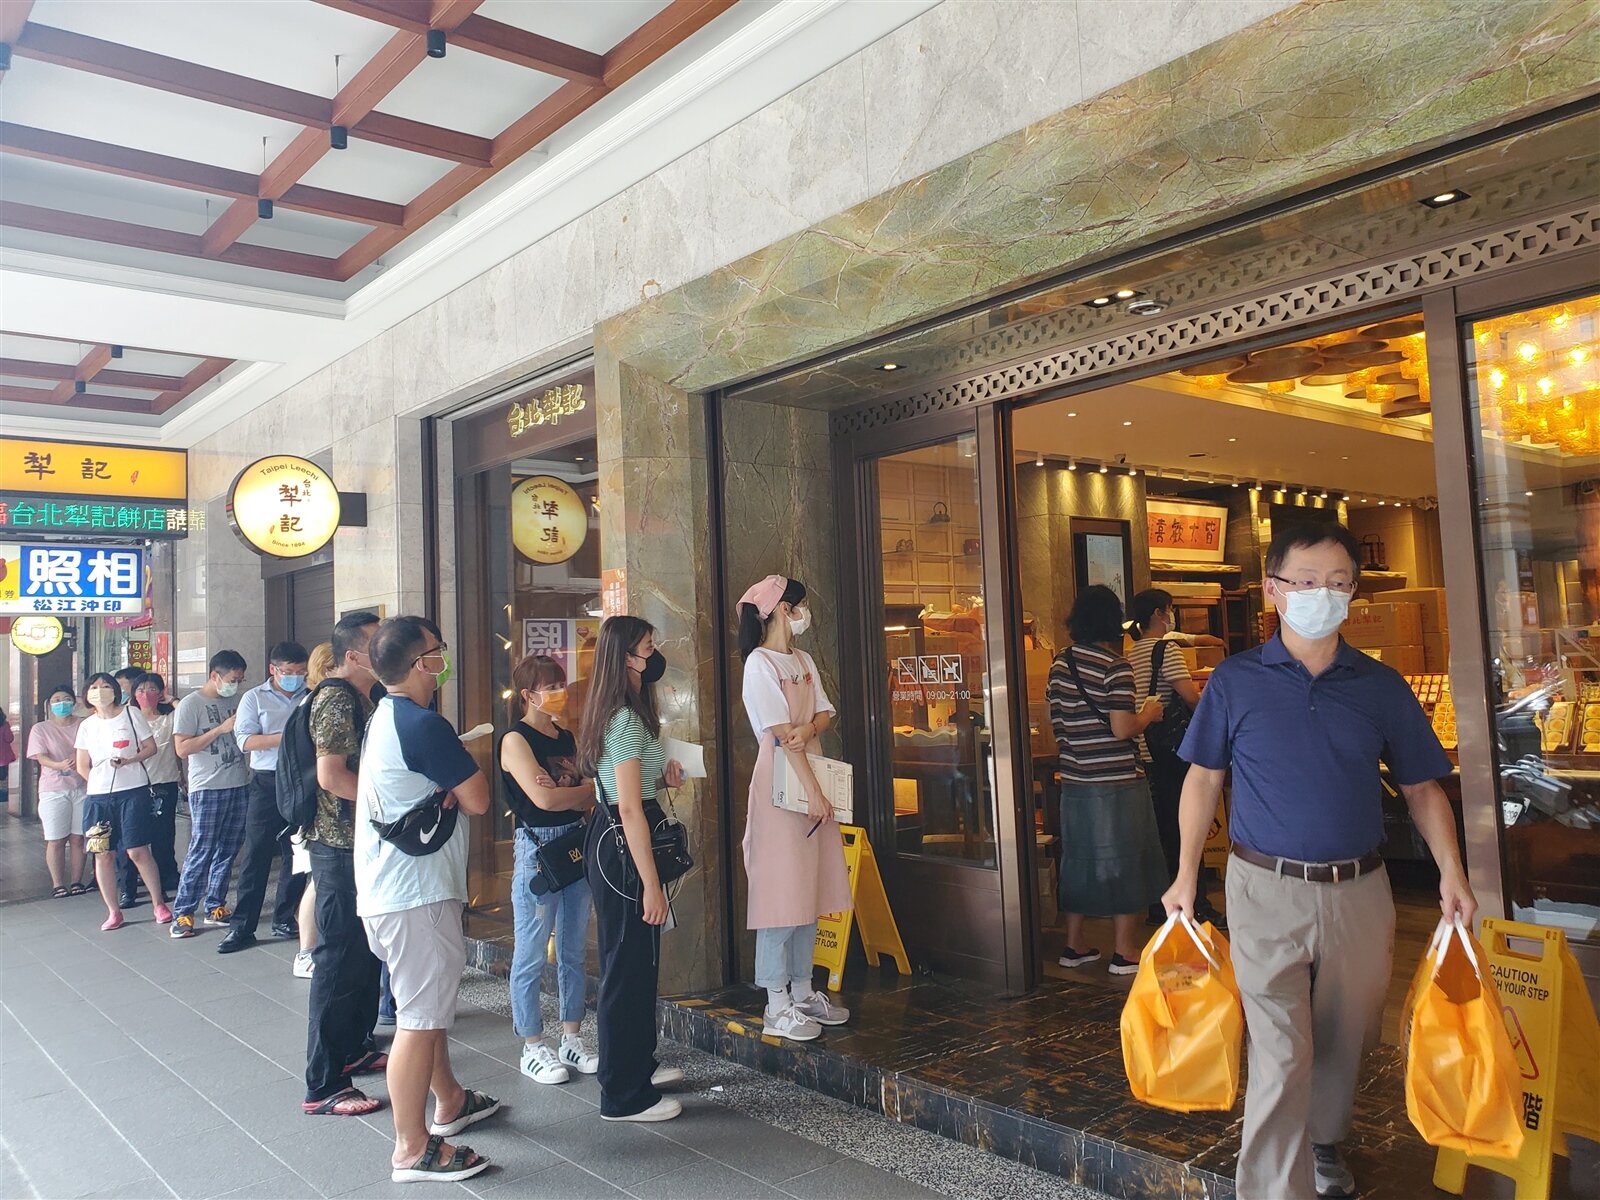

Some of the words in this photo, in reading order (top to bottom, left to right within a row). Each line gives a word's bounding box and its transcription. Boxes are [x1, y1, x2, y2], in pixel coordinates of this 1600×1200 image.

[507, 384, 586, 438] 台北犁記
[24, 451, 112, 480] 犁記
[260, 464, 288, 476] Taipei
[290, 464, 319, 480] Leechi
[302, 479, 311, 496] 台北
[279, 484, 303, 533] 犁記
[27, 549, 138, 596] 照相
[33, 599, 122, 612] 松江沖印
[927, 690, 970, 700] 09:00~21:00
[820, 938, 838, 949] FLOOR
[1489, 964, 1538, 985] CAUTION
[1504, 981, 1527, 997] YOUR
[1527, 986, 1549, 1001] STEP
